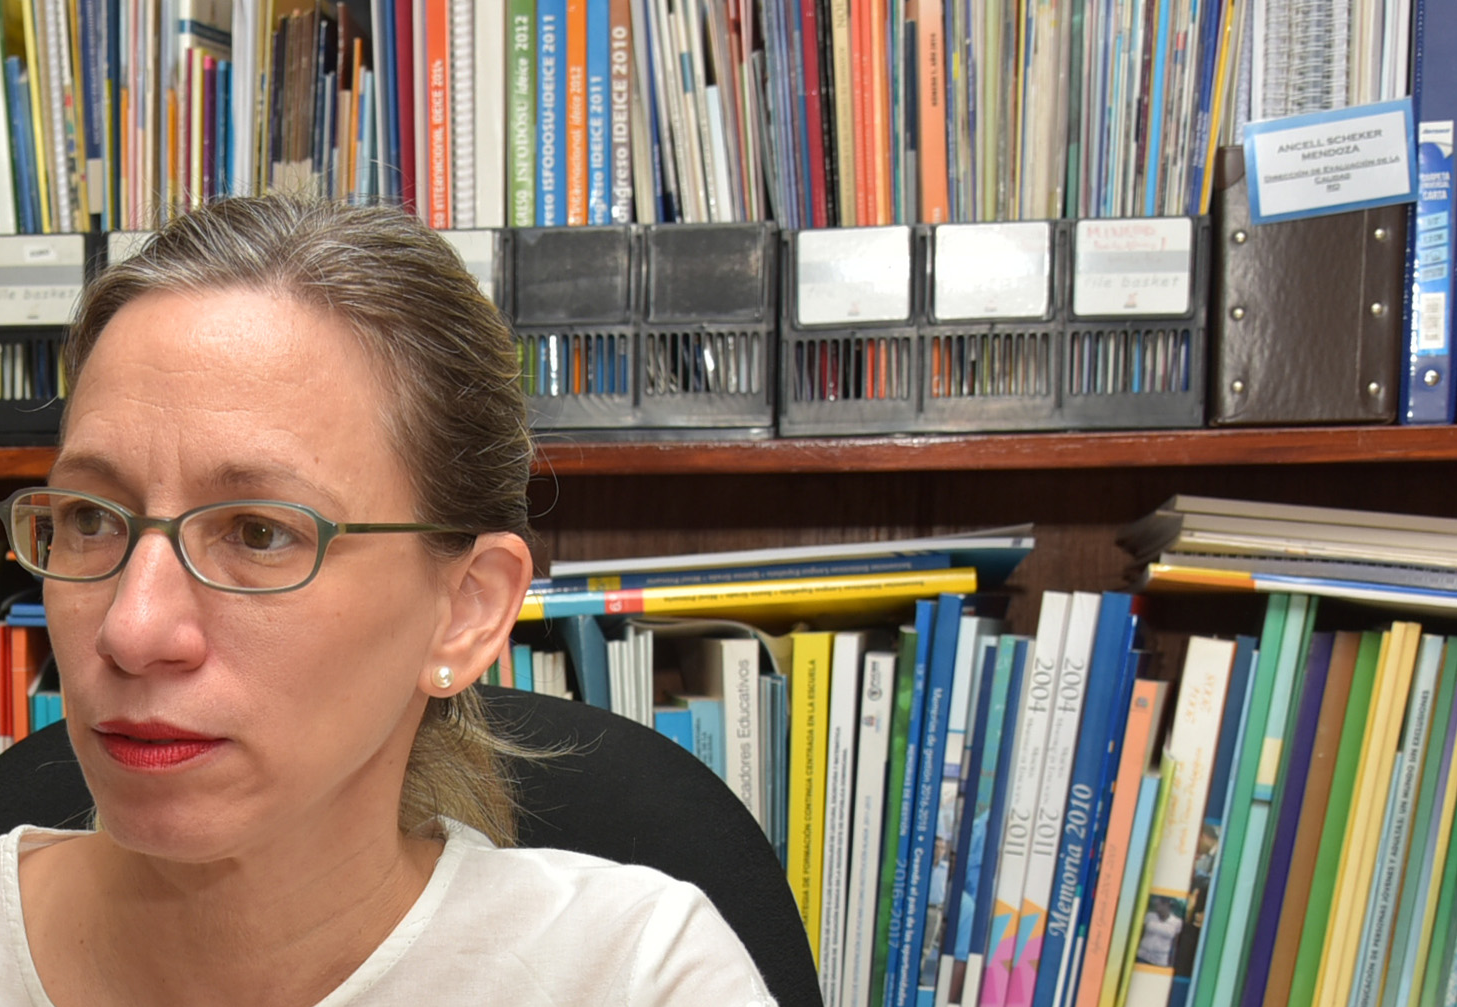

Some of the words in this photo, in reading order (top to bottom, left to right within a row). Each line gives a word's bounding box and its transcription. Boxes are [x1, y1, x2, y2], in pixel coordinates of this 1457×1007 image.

[514, 15, 529, 51] 2012
[542, 15, 556, 53] 2011
[611, 26, 627, 75] 2010
[515, 57, 530, 95] ideice
[589, 75, 603, 114] 2011
[612, 80, 628, 143] IDEICE
[590, 117, 604, 169] IDEICE
[1277, 139, 1325, 154] ANCELL
[1326, 129, 1383, 146] SCHEKER
[1301, 145, 1361, 161] MENDOZA
[806, 659, 816, 699] ESCUELA
[1026, 656, 1055, 715] 2004
[1056, 655, 1085, 715] 2004
[735, 659, 750, 739] Educativos
[806, 701, 815, 712] LA
[928, 687, 943, 733] Memorias
[1411, 689, 1430, 746] EXCLUSIONES
[806, 714, 814, 726] EN
[805, 728, 814, 774] CENTRADA
[926, 733, 937, 747] de
[1408, 748, 1418, 763] SIN
[903, 743, 915, 786] MEMORIAS
[920, 748, 936, 783] gestión
[1401, 764, 1415, 799] MUNDO
[804, 777, 813, 820] CONTINUA
[902, 787, 910, 798] DE
[1398, 800, 1408, 814] UN
[899, 800, 911, 836] GESTIÓN
[1003, 807, 1030, 856] 2011
[1032, 807, 1060, 856] 2011
[1389, 815, 1405, 857] ADULTAS:
[802, 823, 812, 874] FORMACIÓN
[909, 847, 924, 885] Creando
[1046, 842, 1082, 937] Memoria
[1064, 782, 1091, 838] 2010
[802, 876, 811, 888] DE
[908, 886, 919, 896] el
[1380, 865, 1395, 902] JÓVENES
[886, 857, 907, 949] 2016-2017
[904, 916, 915, 928] de
[905, 896, 918, 915] país
[902, 929, 914, 942] las
[1371, 903, 1387, 947] PERSONAS
[1369, 948, 1378, 960] DE
[894, 943, 913, 1007] oportunidades
